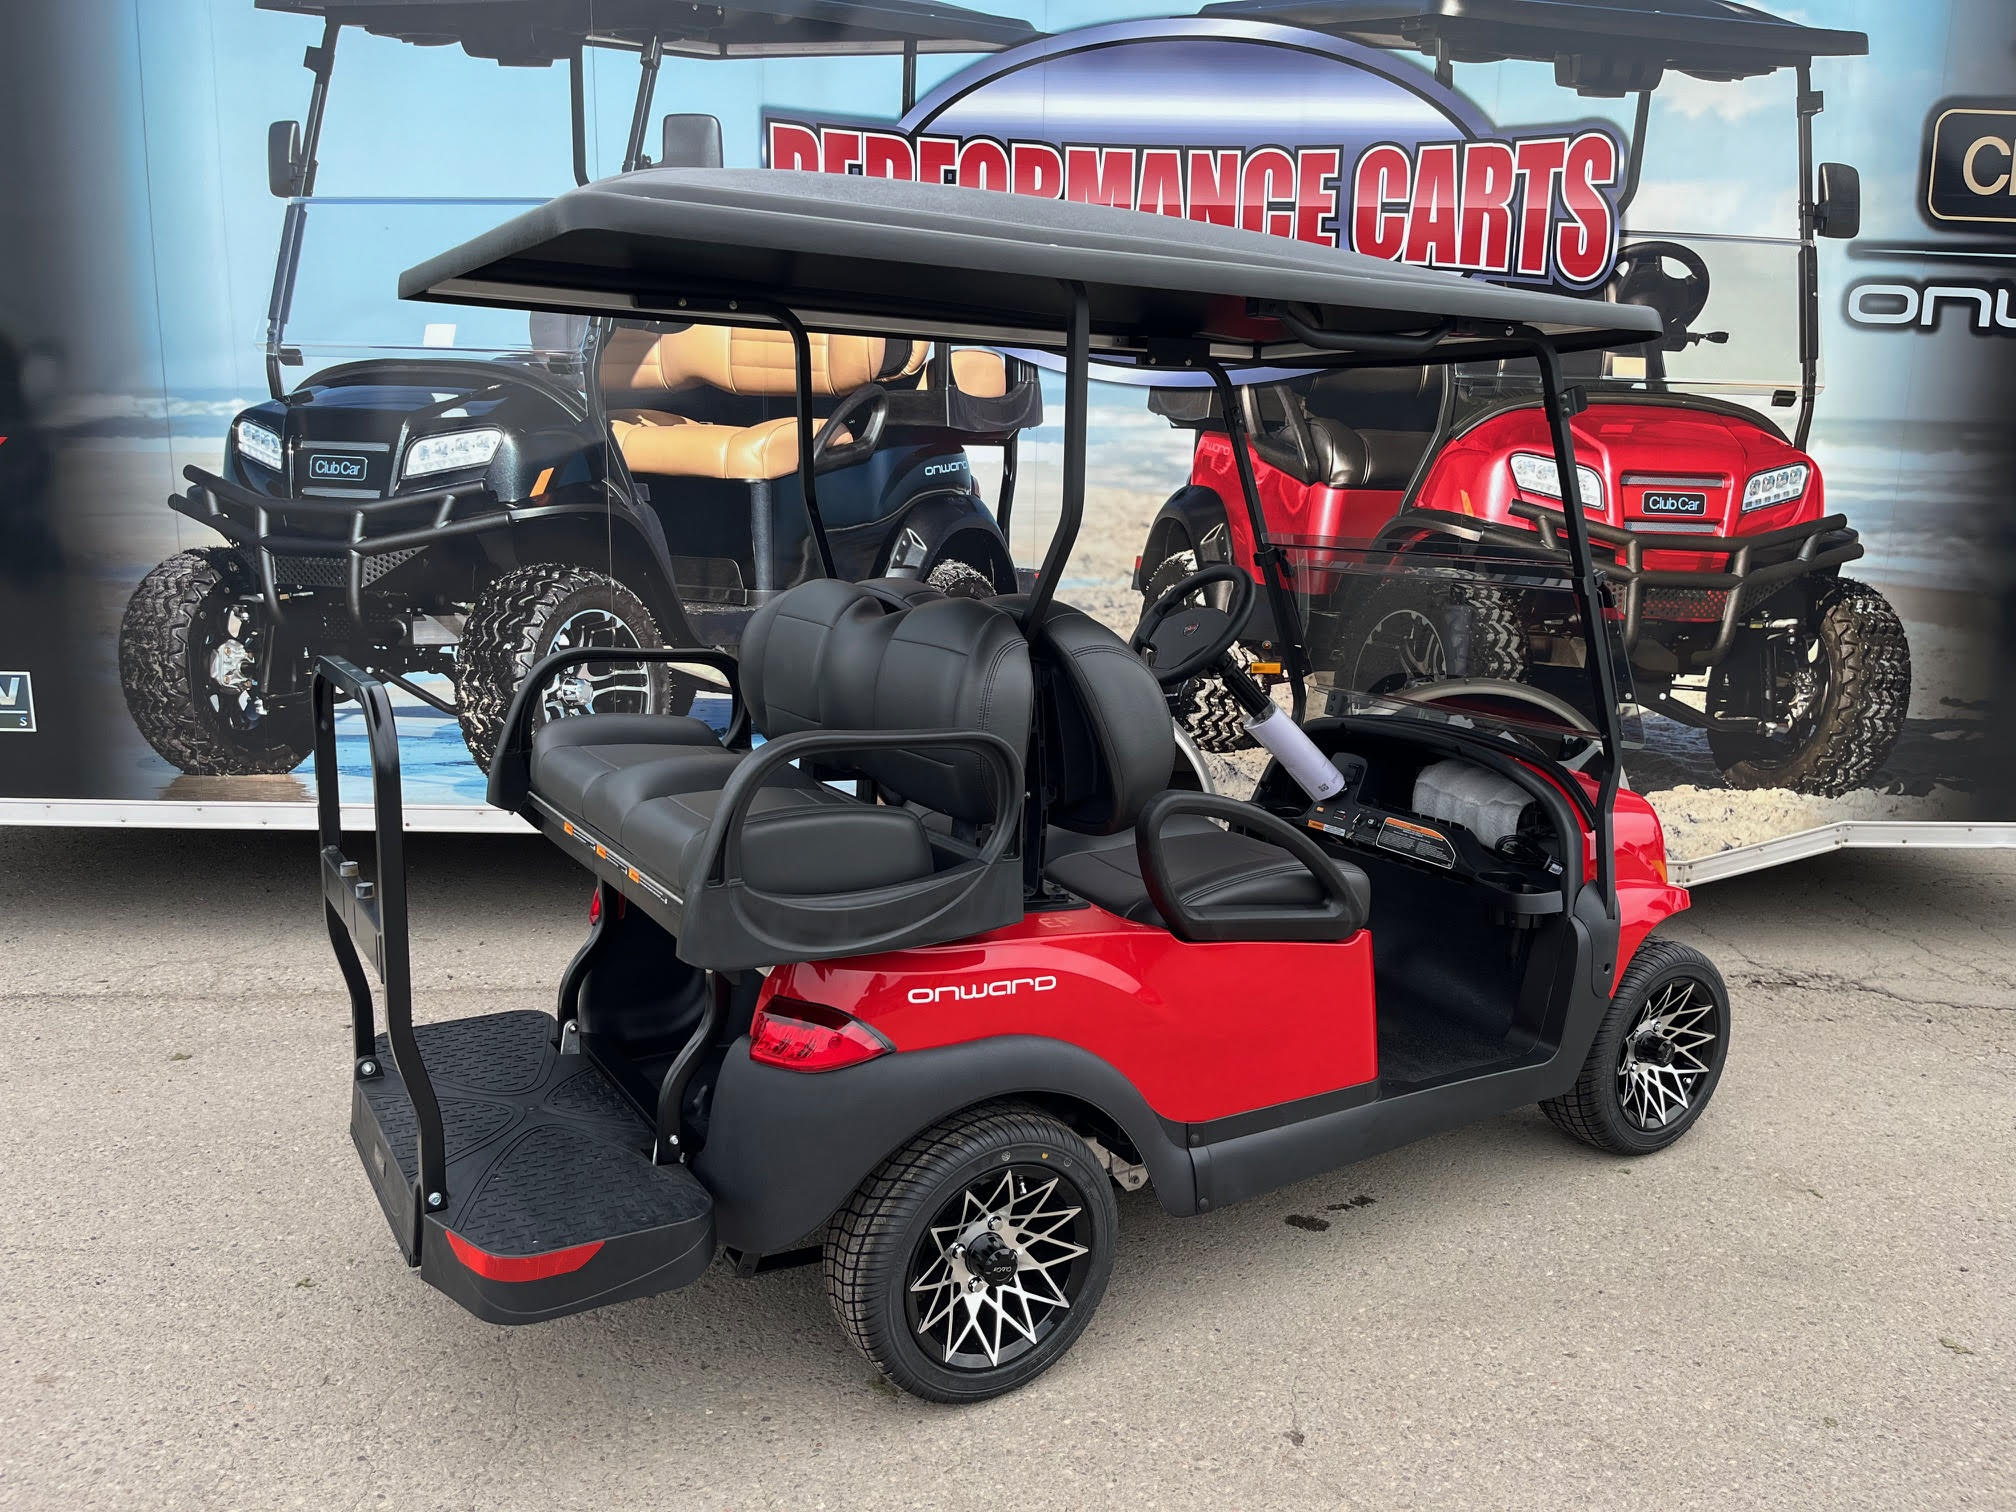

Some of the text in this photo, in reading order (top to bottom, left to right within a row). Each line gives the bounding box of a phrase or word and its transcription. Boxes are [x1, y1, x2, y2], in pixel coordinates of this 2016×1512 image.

[1352, 132, 1616, 282] CARTS
[315, 460, 360, 475] Club Car
[1649, 496, 1700, 511] Club Car
